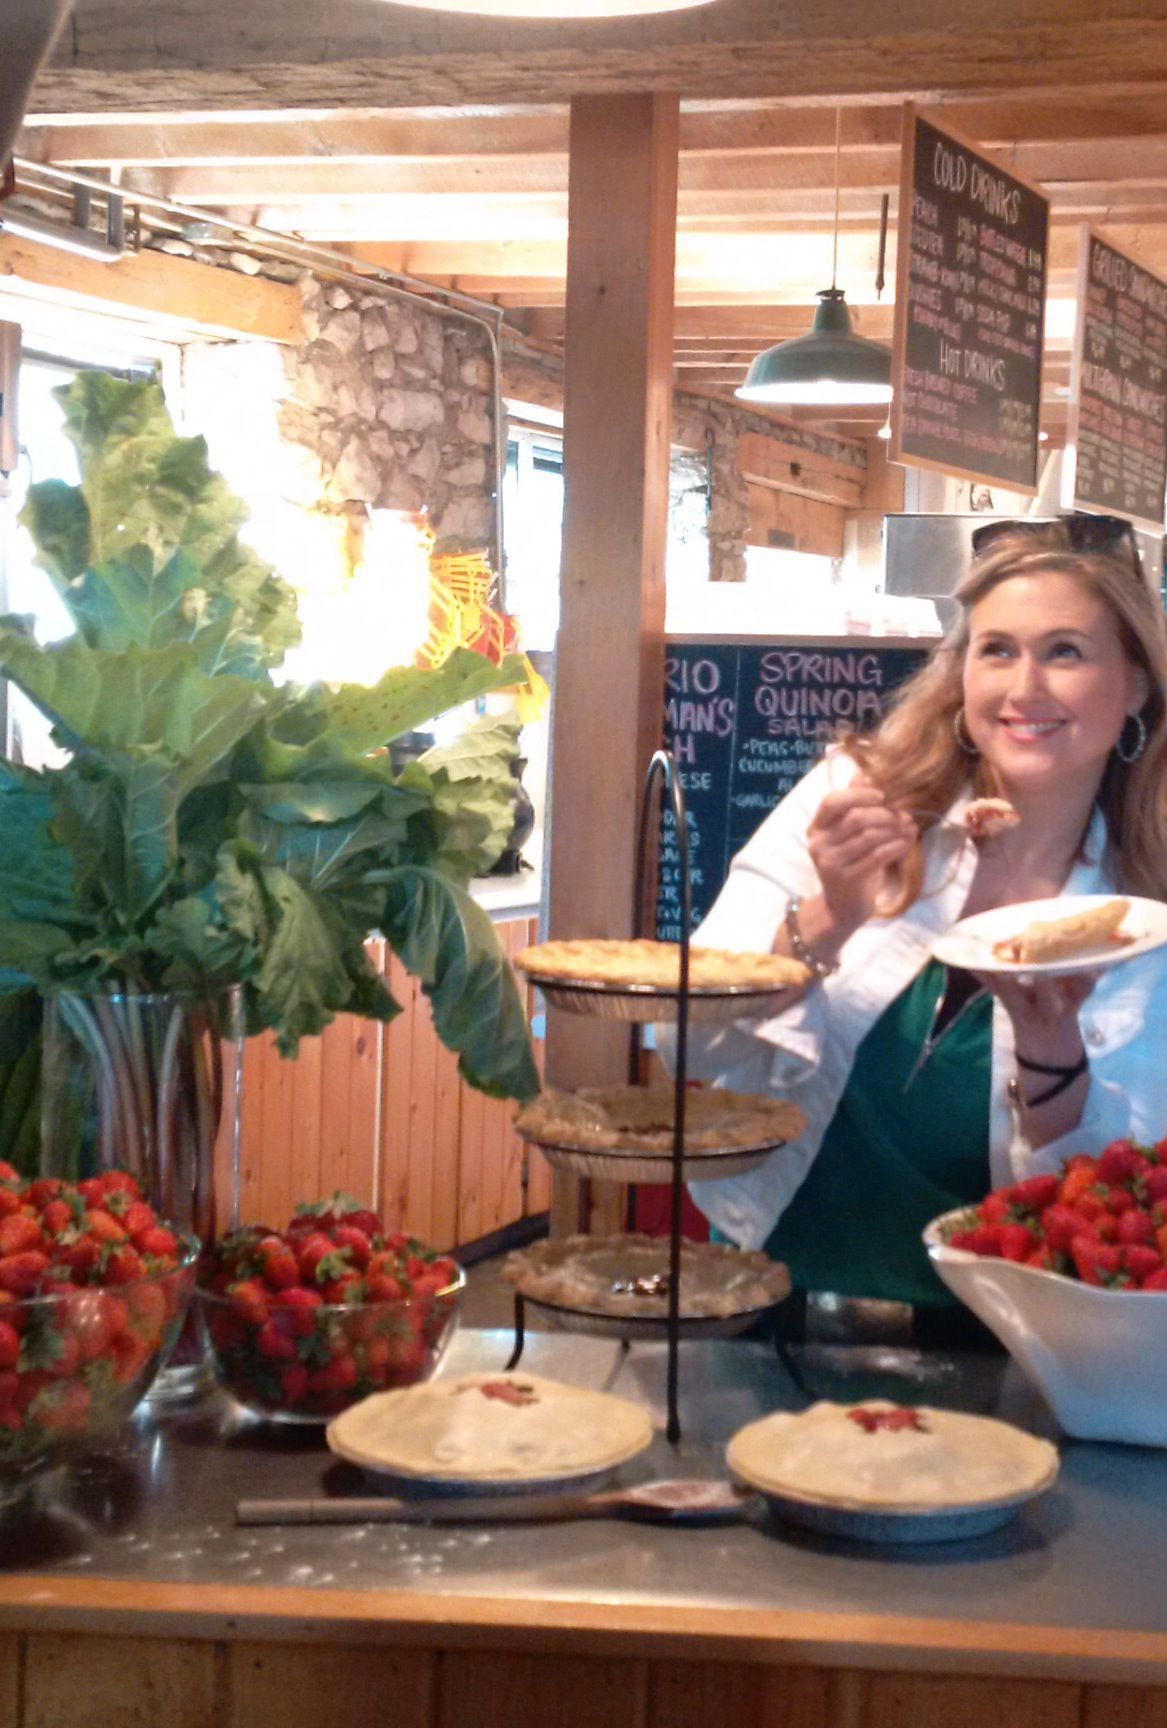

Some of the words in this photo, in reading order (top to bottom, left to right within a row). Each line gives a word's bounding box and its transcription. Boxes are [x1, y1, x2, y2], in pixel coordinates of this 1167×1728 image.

[934, 142, 967, 192] COLD
[970, 164, 1021, 225] DRINKS
[963, 350, 1006, 391] DRINKS
[760, 652, 882, 686] SPRING
[755, 686, 882, 719] QUINOA
